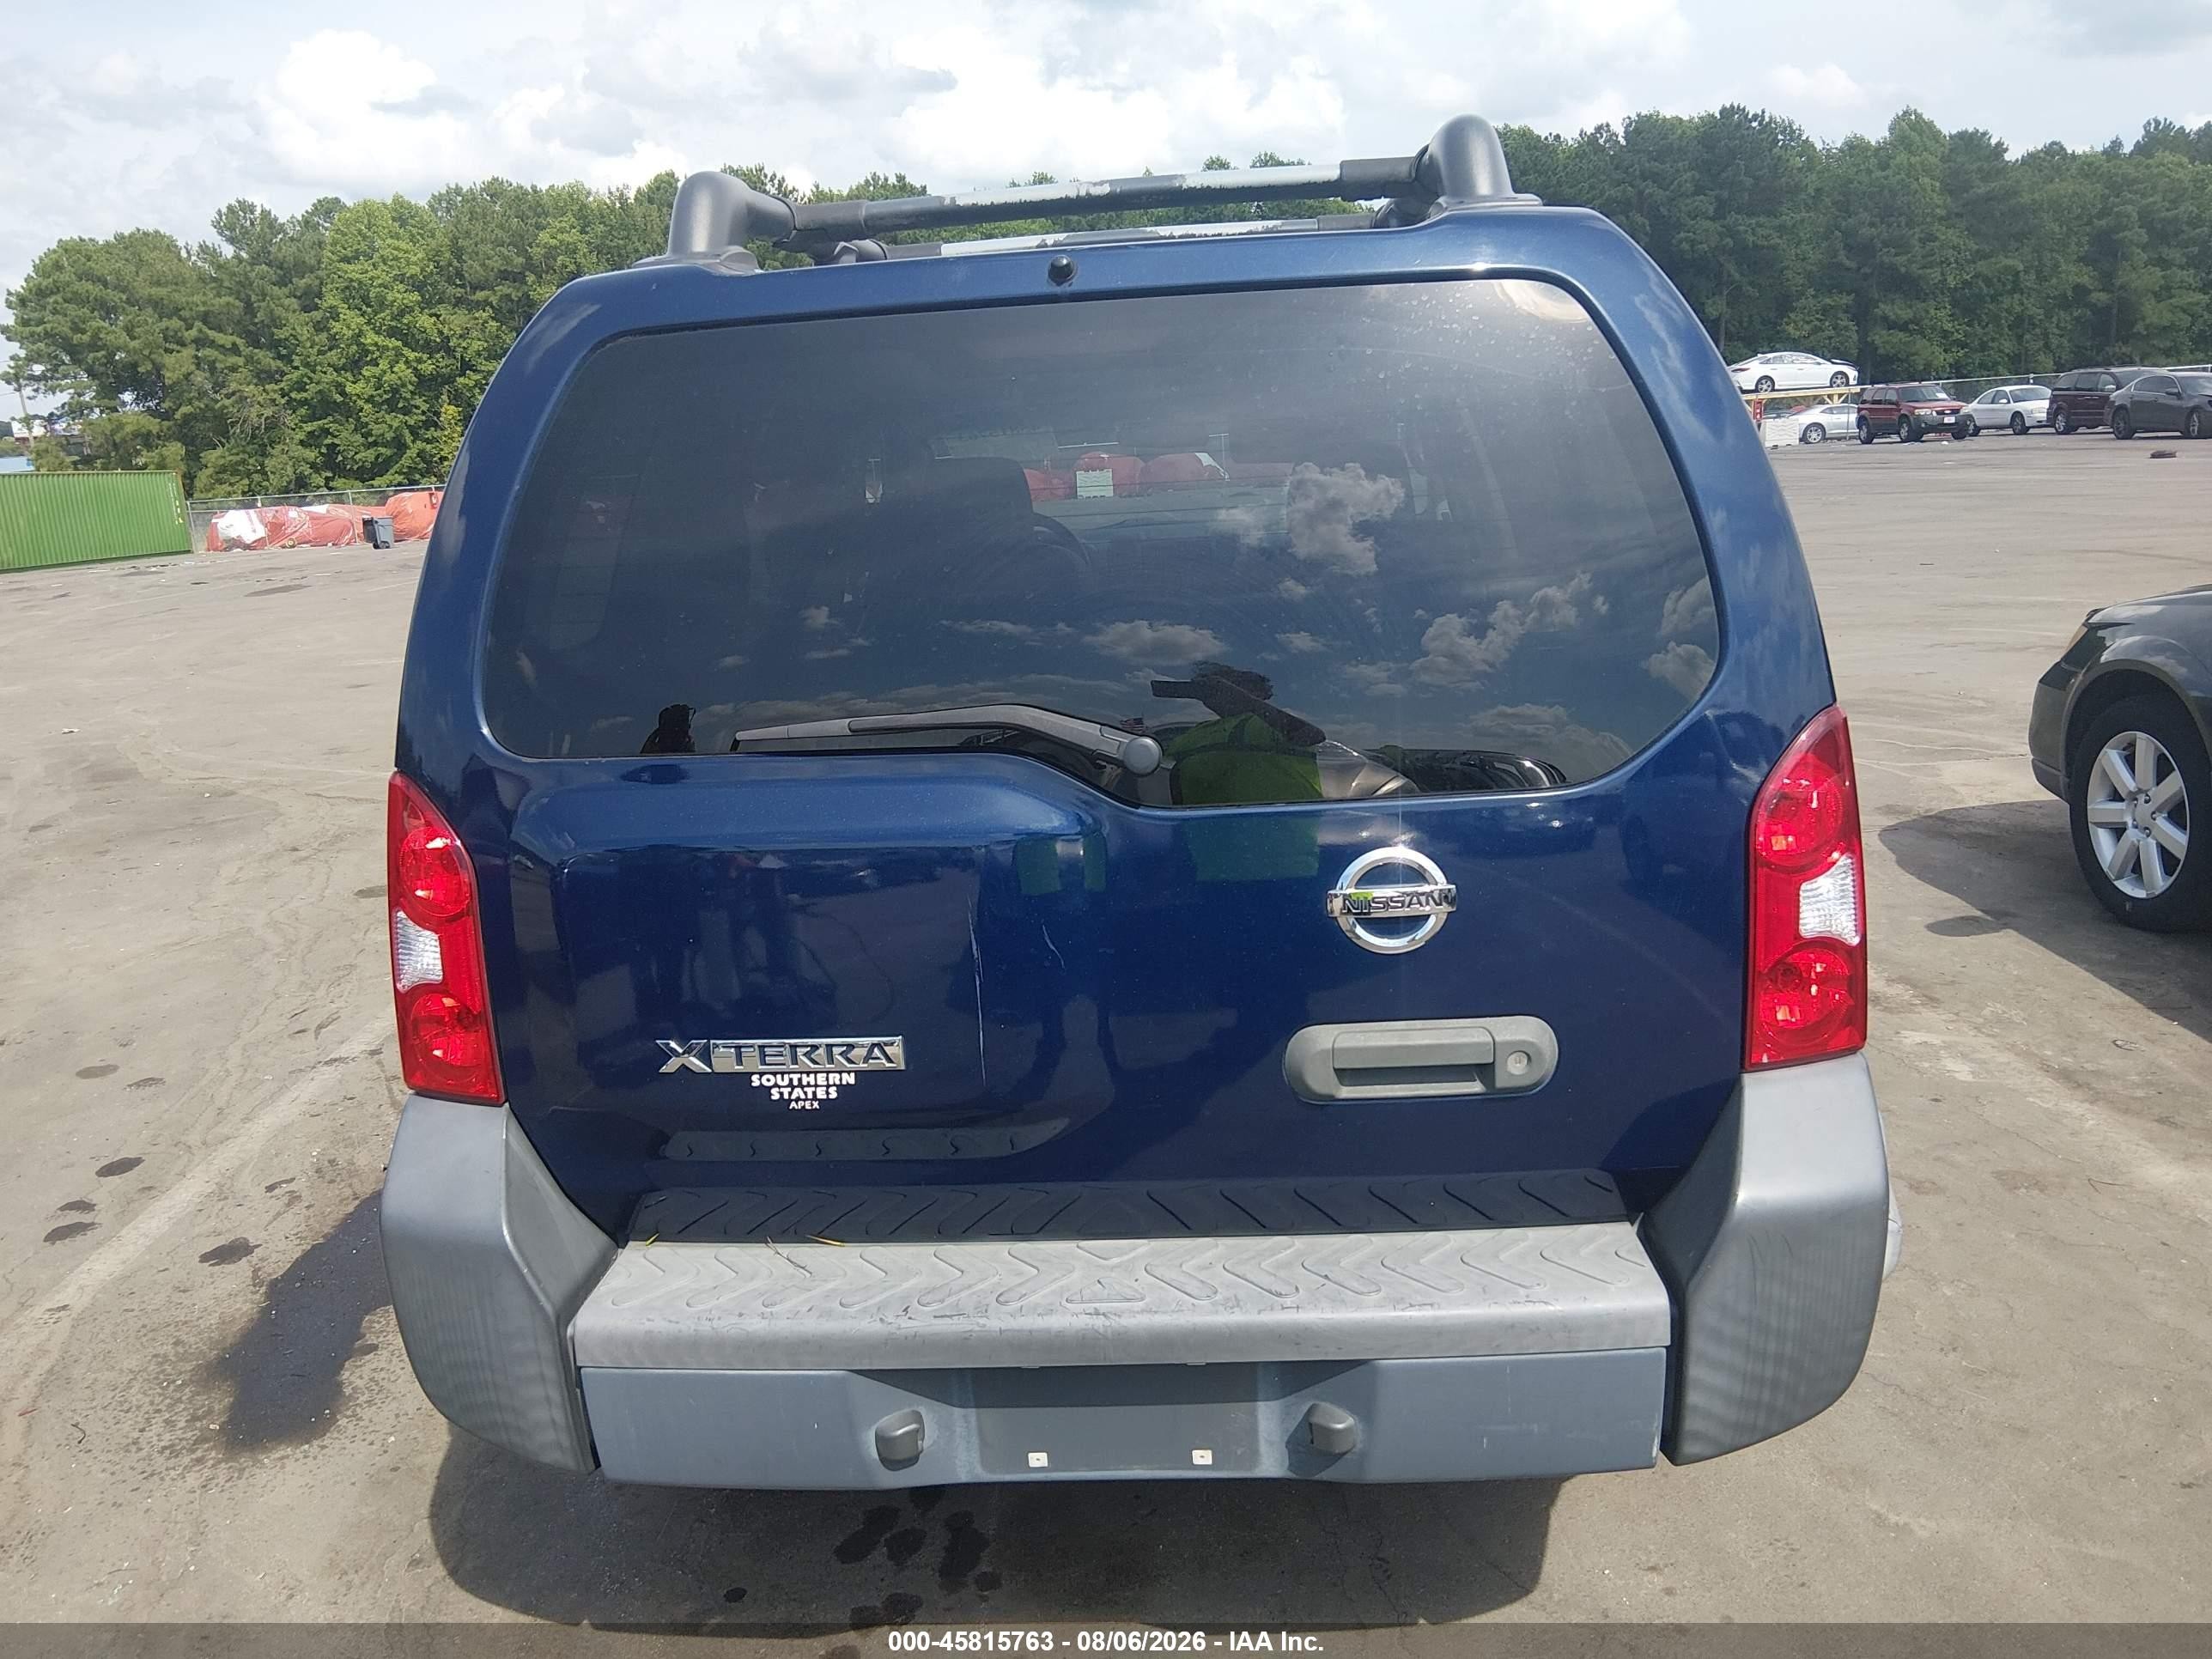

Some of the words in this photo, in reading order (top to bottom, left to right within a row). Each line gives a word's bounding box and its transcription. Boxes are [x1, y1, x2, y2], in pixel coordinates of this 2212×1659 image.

[1342, 890, 1444, 913] NISSAN
[750, 1073, 856, 1087] SOUTHERN
[769, 1086, 839, 1100] STATES
[788, 1100, 820, 1109] APEX
